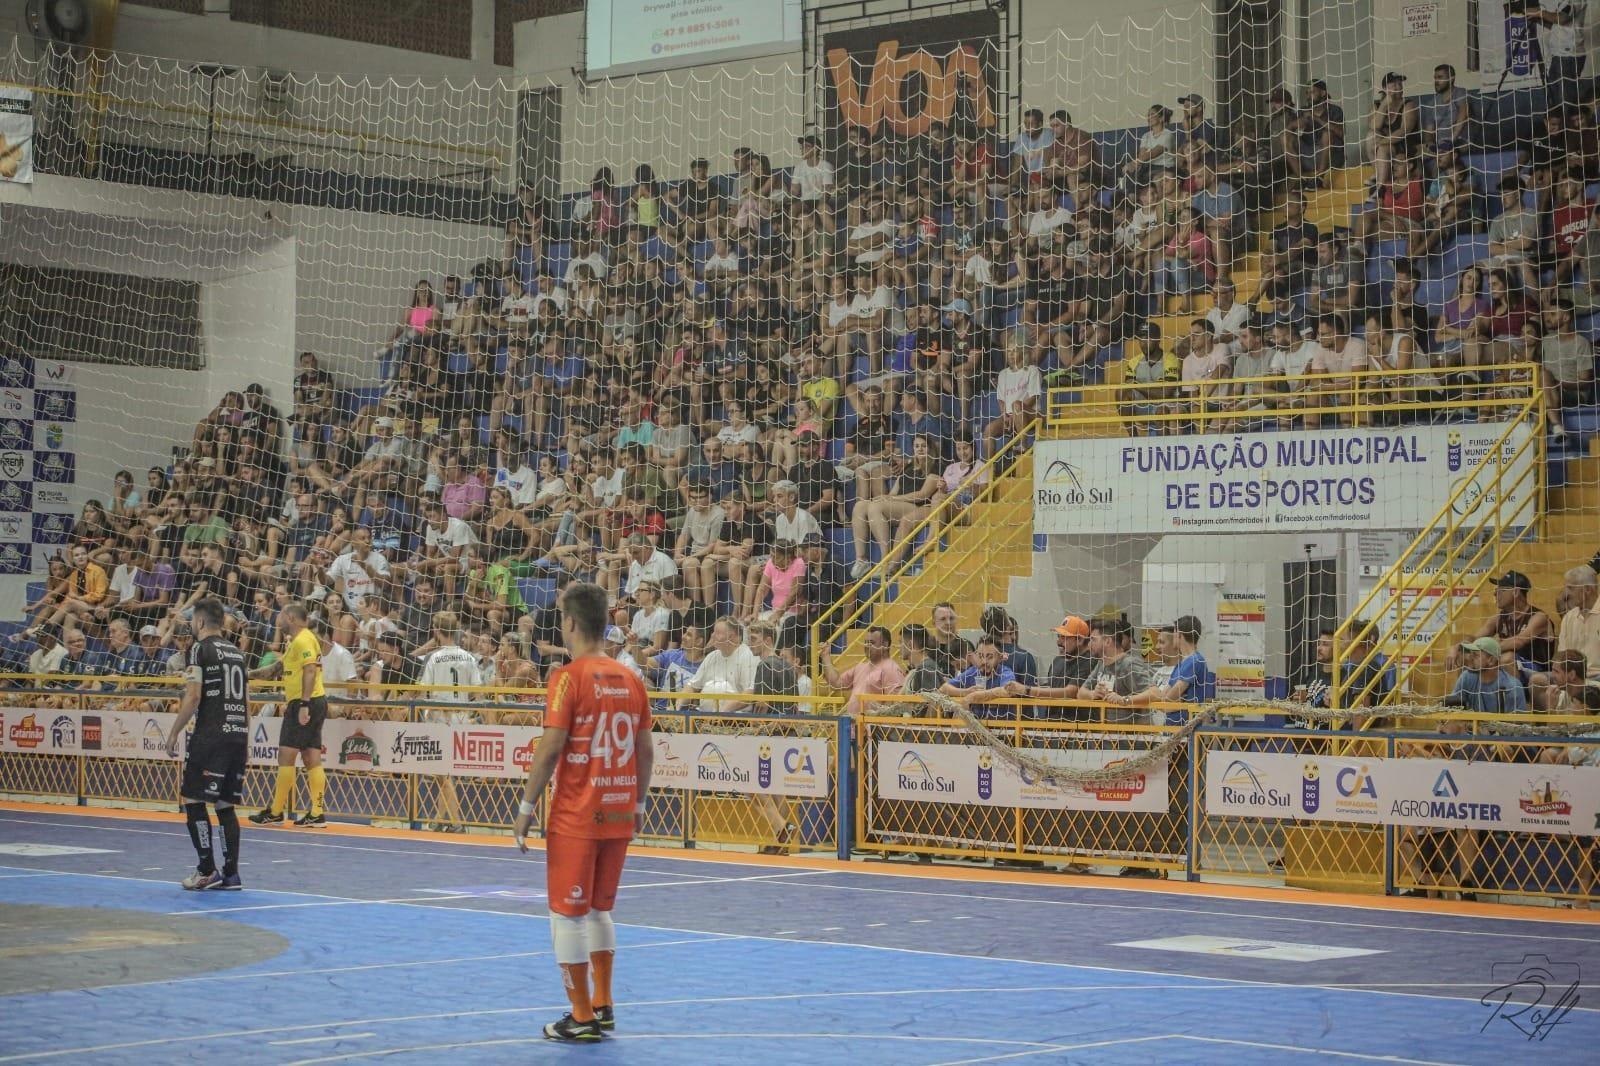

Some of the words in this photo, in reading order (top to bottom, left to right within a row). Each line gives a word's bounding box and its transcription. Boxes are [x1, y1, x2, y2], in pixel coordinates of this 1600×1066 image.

[1412, 21, 1428, 30] 1344
[1122, 436, 1267, 475] FUNDAÇÃO
[1277, 437, 1427, 467] MUNICIPAL
[1038, 489, 1061, 505] Rio
[1066, 488, 1085, 504] do
[1089, 487, 1113, 504] Sul
[1166, 483, 1200, 510] DE
[1209, 477, 1376, 509] DESPORTOS
[223, 664, 244, 700] 10
[224, 703, 246, 713] DIOGO
[143, 738, 155, 751] Rio
[404, 740, 442, 755] FUTSAL
[454, 731, 504, 762] Nema
[591, 711, 635, 769] 49
[591, 775, 612, 787] VINI
[613, 775, 637, 786] MELLO
[698, 765, 716, 781] Rio
[718, 768, 731, 782] do
[733, 768, 750, 783] Sul
[898, 774, 917, 791] Rio
[920, 777, 935, 792] do
[936, 776, 955, 793] Sul
[1222, 786, 1245, 804] Rio
[1249, 790, 1265, 806] do
[1268, 789, 1291, 807] Sul
[1391, 800, 1502, 821] AGROMASTER
